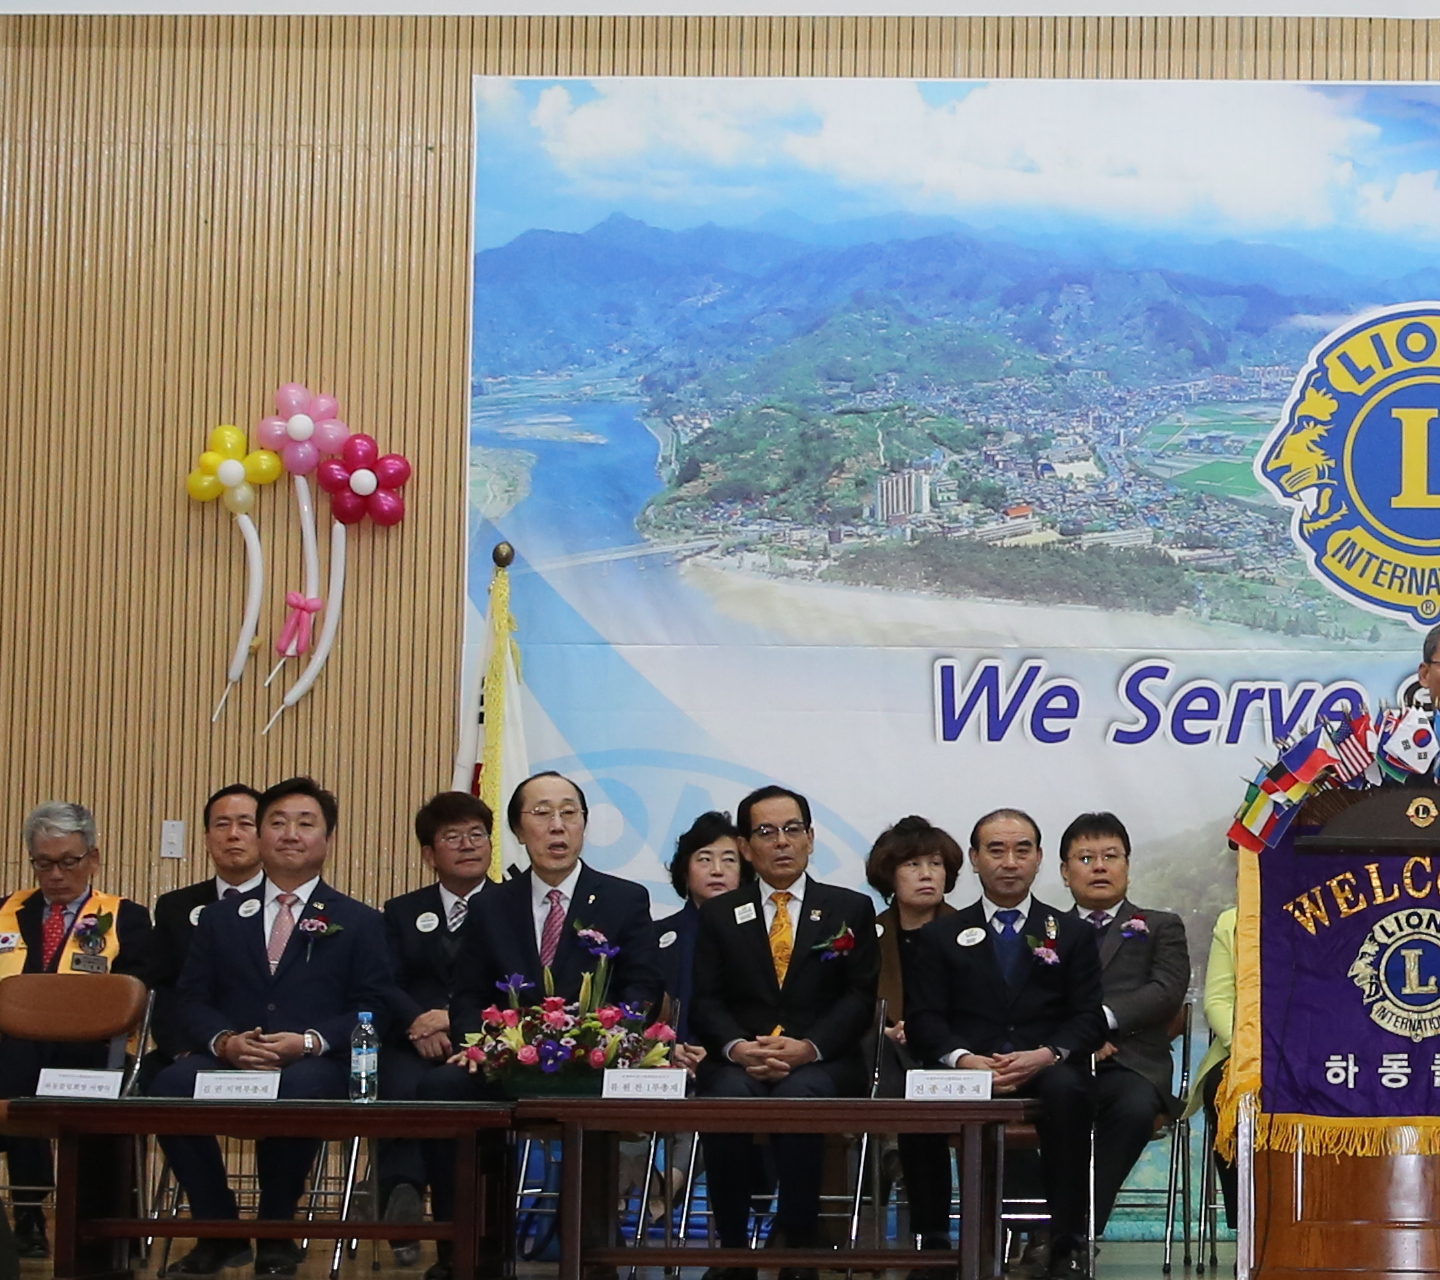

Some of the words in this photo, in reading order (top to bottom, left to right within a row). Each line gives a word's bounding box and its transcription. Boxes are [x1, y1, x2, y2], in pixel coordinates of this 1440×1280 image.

[938, 663, 1081, 745] We
[1111, 662, 1365, 747] Serve
[1399, 948, 1439, 995] L
